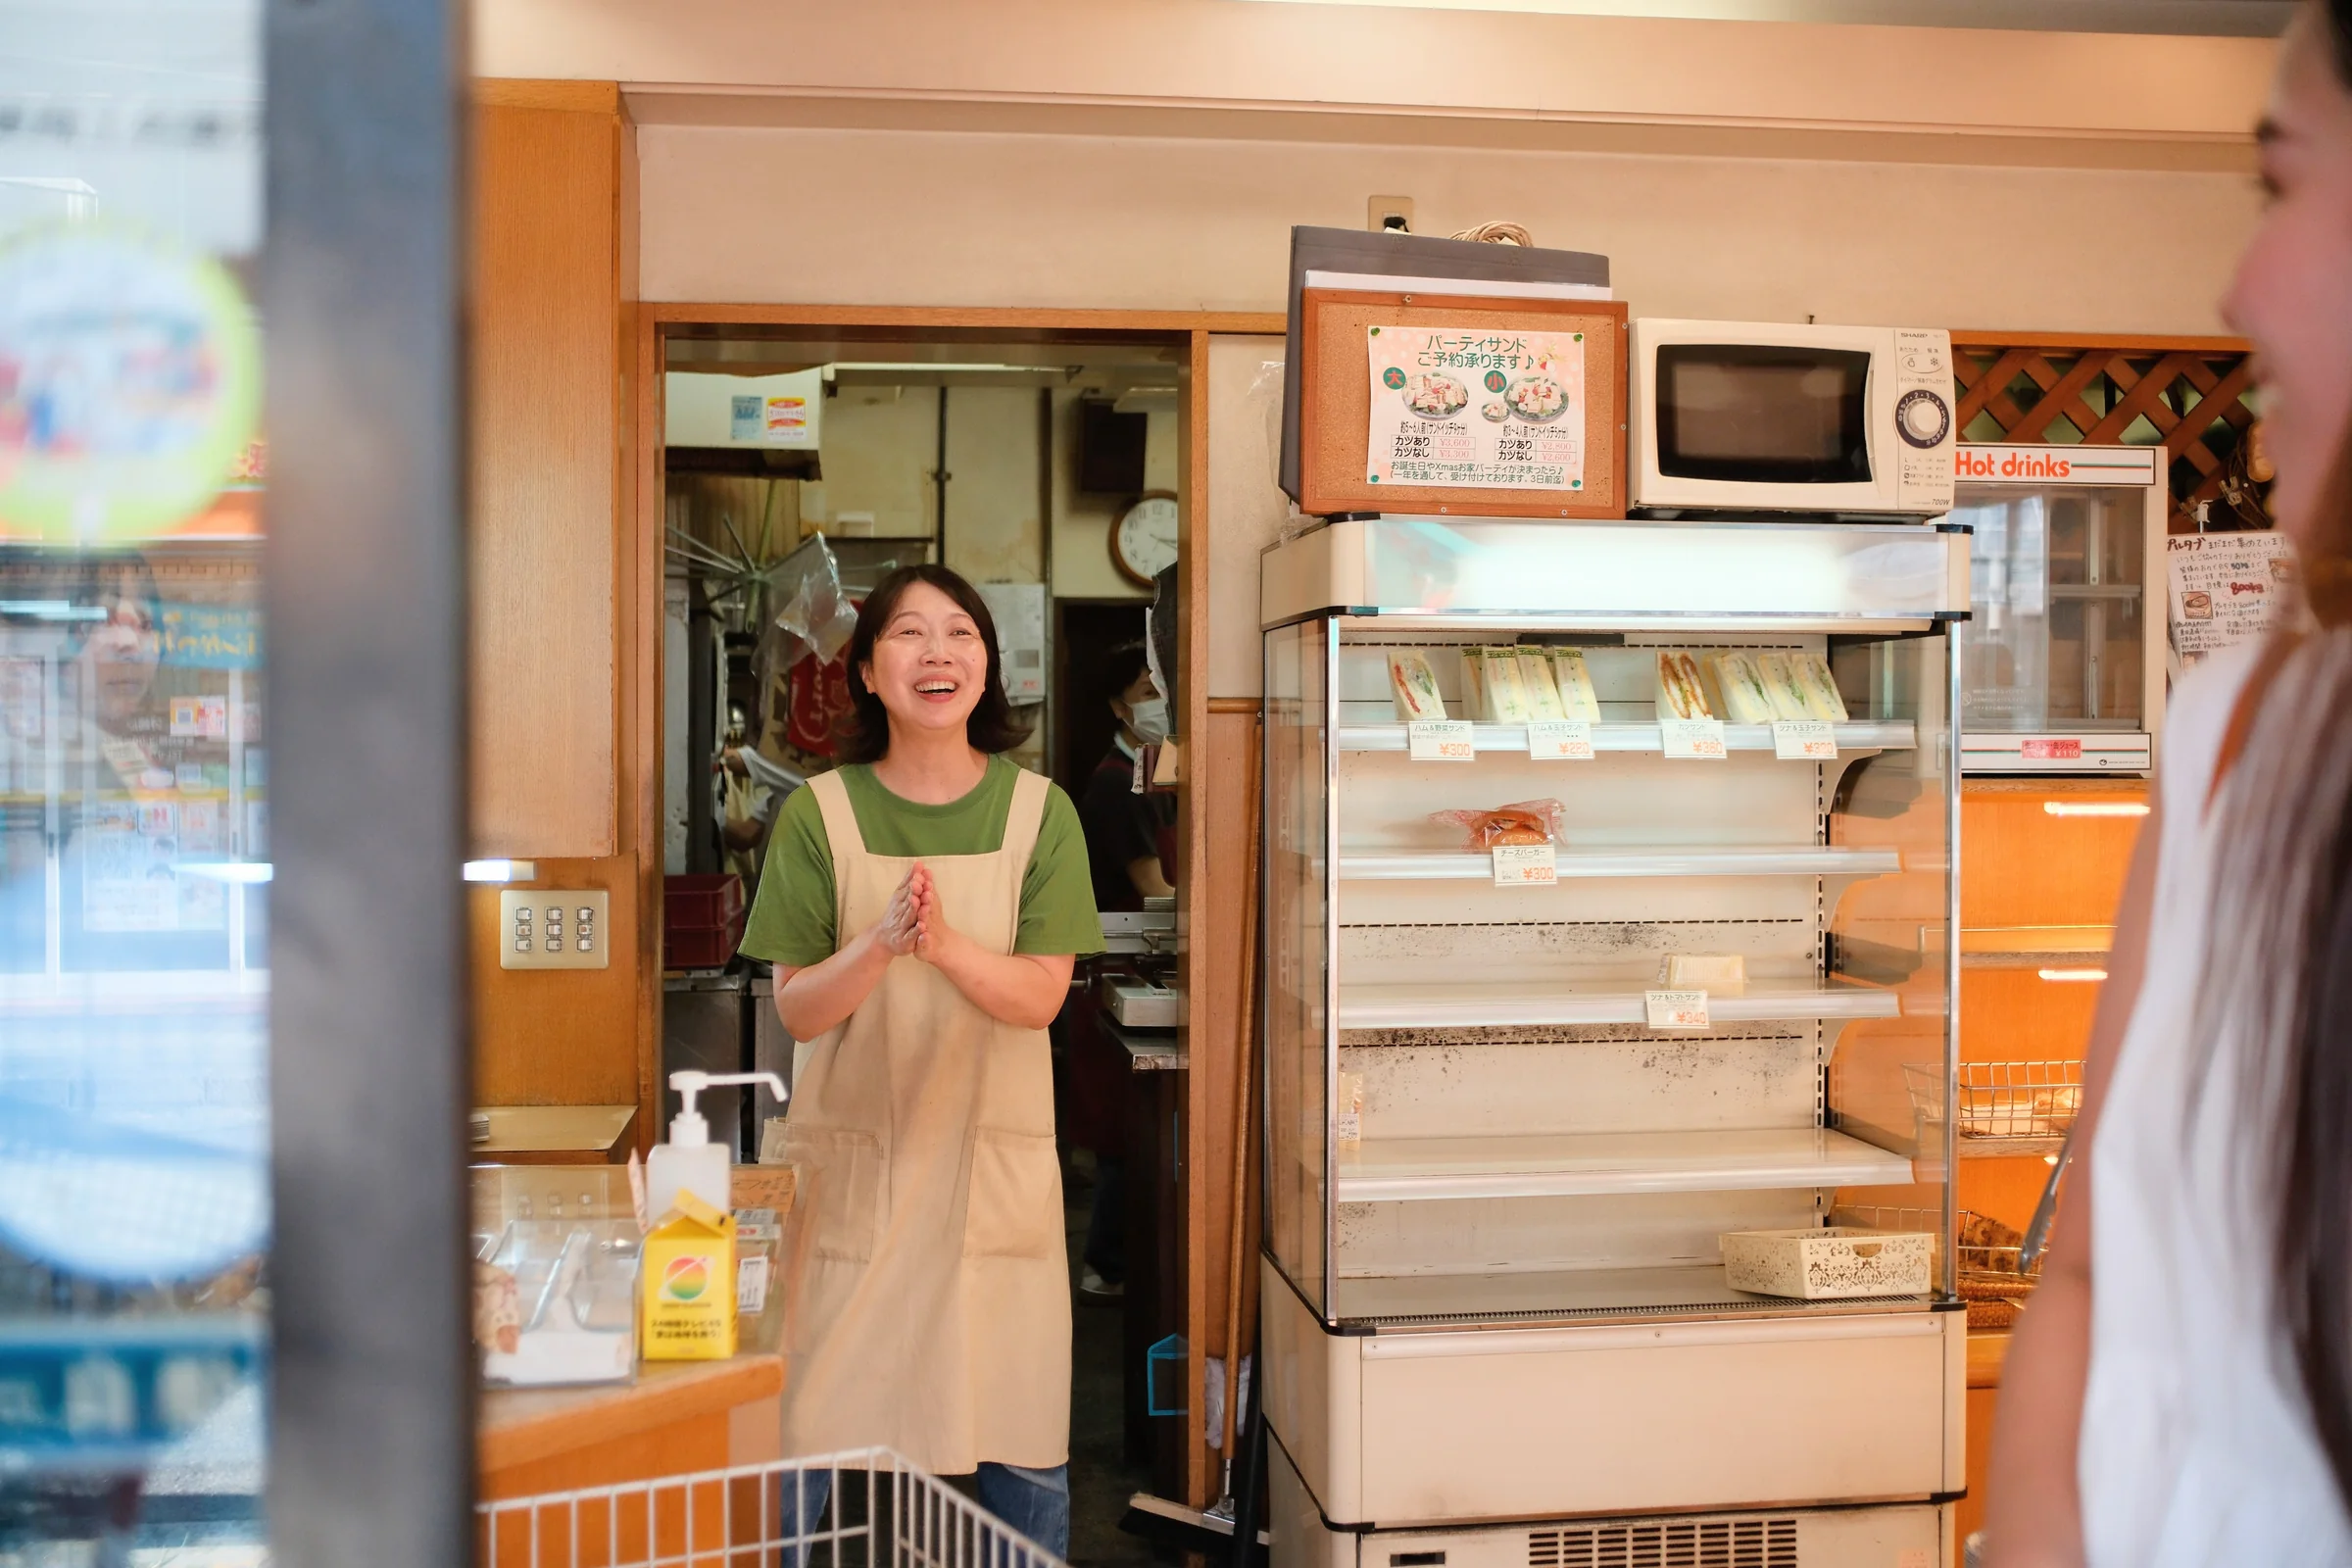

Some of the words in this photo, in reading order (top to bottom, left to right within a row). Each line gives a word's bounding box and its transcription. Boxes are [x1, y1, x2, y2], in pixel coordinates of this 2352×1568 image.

[1427, 335, 1527, 353] パーティサンド
[1387, 370, 1402, 386] 大
[1488, 372, 1504, 390] 小
[1396, 436, 1431, 447] カツあり
[1499, 439, 1533, 449] カツあり
[1395, 447, 1429, 457] カツなし
[1497, 451, 1533, 461] カツなし
[1955, 451, 1994, 476] Hot
[2001, 452, 2070, 478] drinks
[2168, 537, 2206, 551] プルタブ
[1440, 743, 1470, 757] ¥300
[1523, 867, 1553, 880] ¥300
[1677, 1011, 1705, 1023] ¥340
